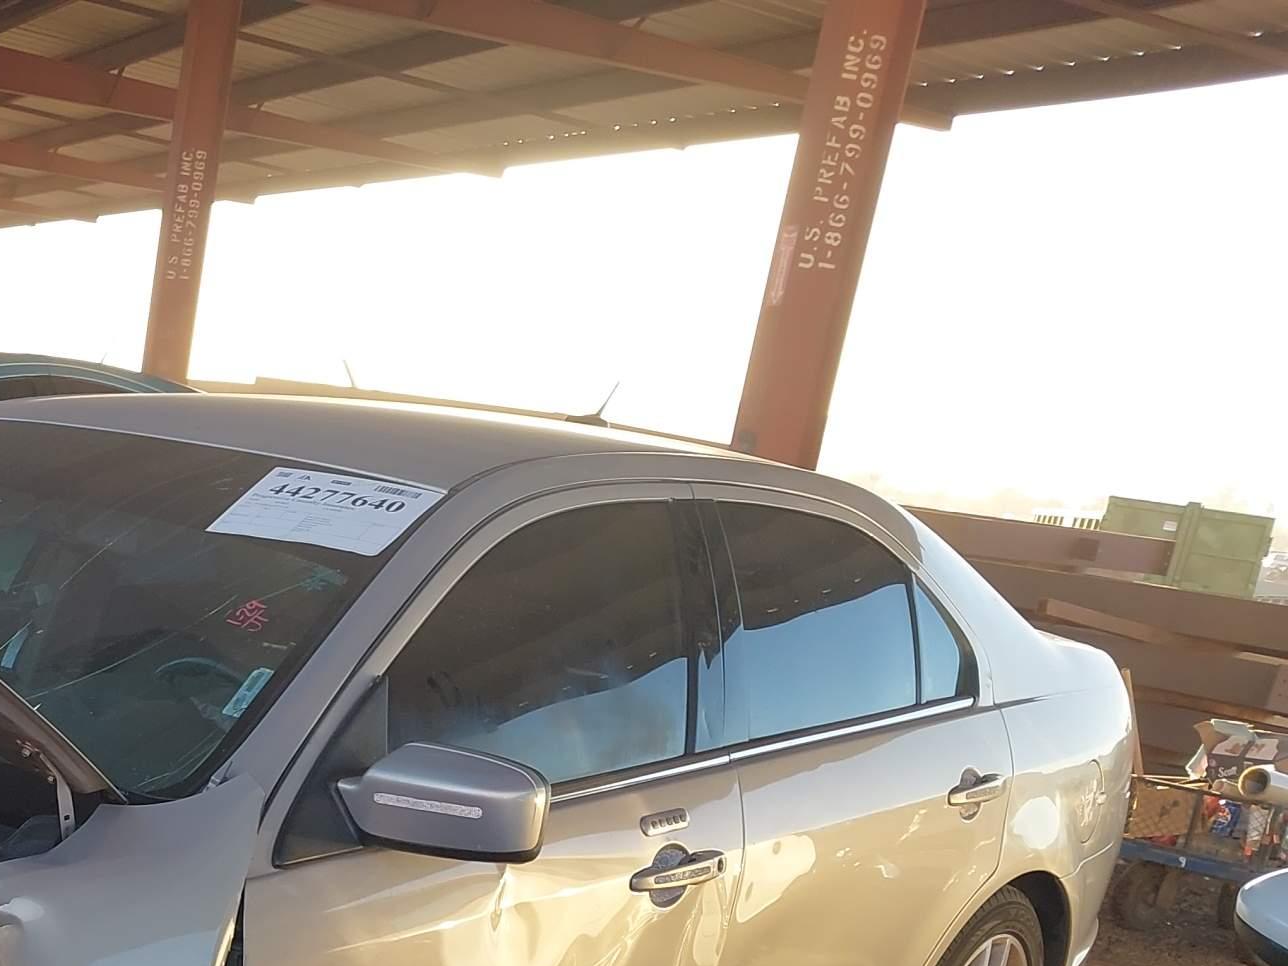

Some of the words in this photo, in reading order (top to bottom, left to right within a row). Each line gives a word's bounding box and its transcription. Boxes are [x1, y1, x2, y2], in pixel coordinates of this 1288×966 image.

[170, 183, 189, 243] PREFAB
[798, 219, 824, 269] U.S.
[813, 95, 851, 202] PREFAB
[841, 30, 868, 80] INC.
[818, 35, 887, 270] 1-866-799-0969
[269, 483, 406, 513] 44277640
